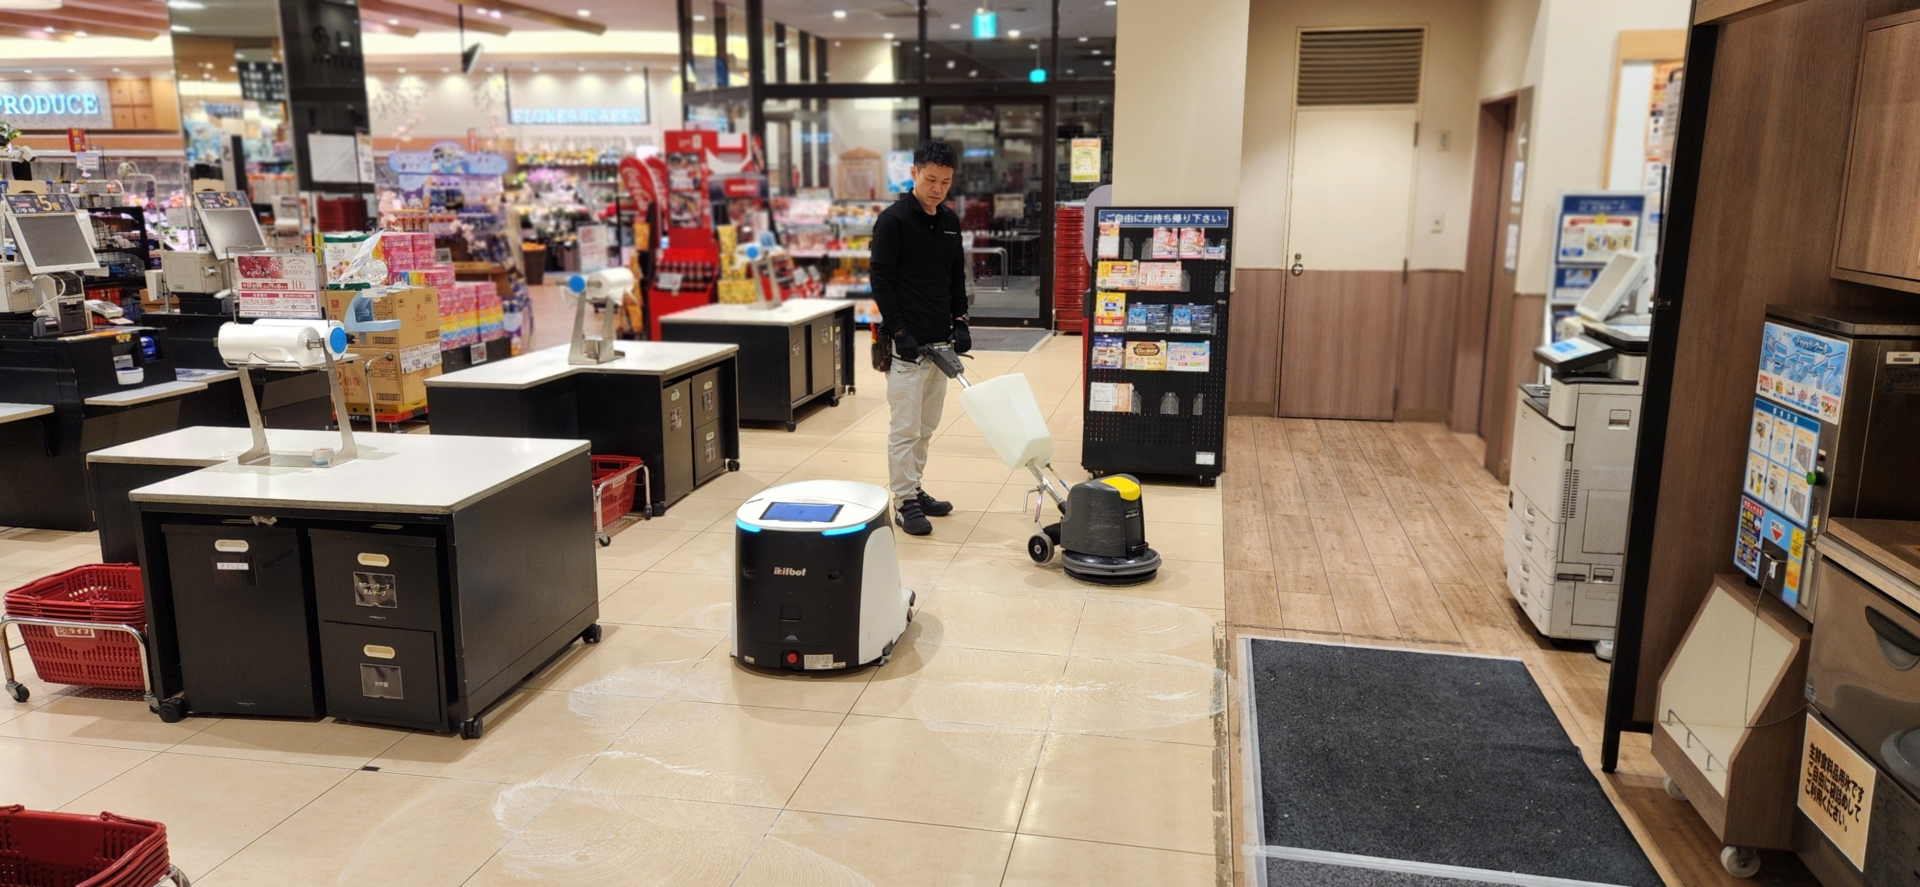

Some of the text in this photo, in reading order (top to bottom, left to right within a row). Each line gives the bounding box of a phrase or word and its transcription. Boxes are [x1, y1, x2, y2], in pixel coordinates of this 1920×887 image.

[1105, 213, 1222, 224] ご自由にお持ち帰り下さい
[1760, 331, 1846, 395] ドライアイス
[1806, 761, 1863, 824] ご自由に袋詰めして
[1808, 741, 1866, 804] 生鮮食料品用氷です
[1804, 777, 1848, 833] ご利用ください。
